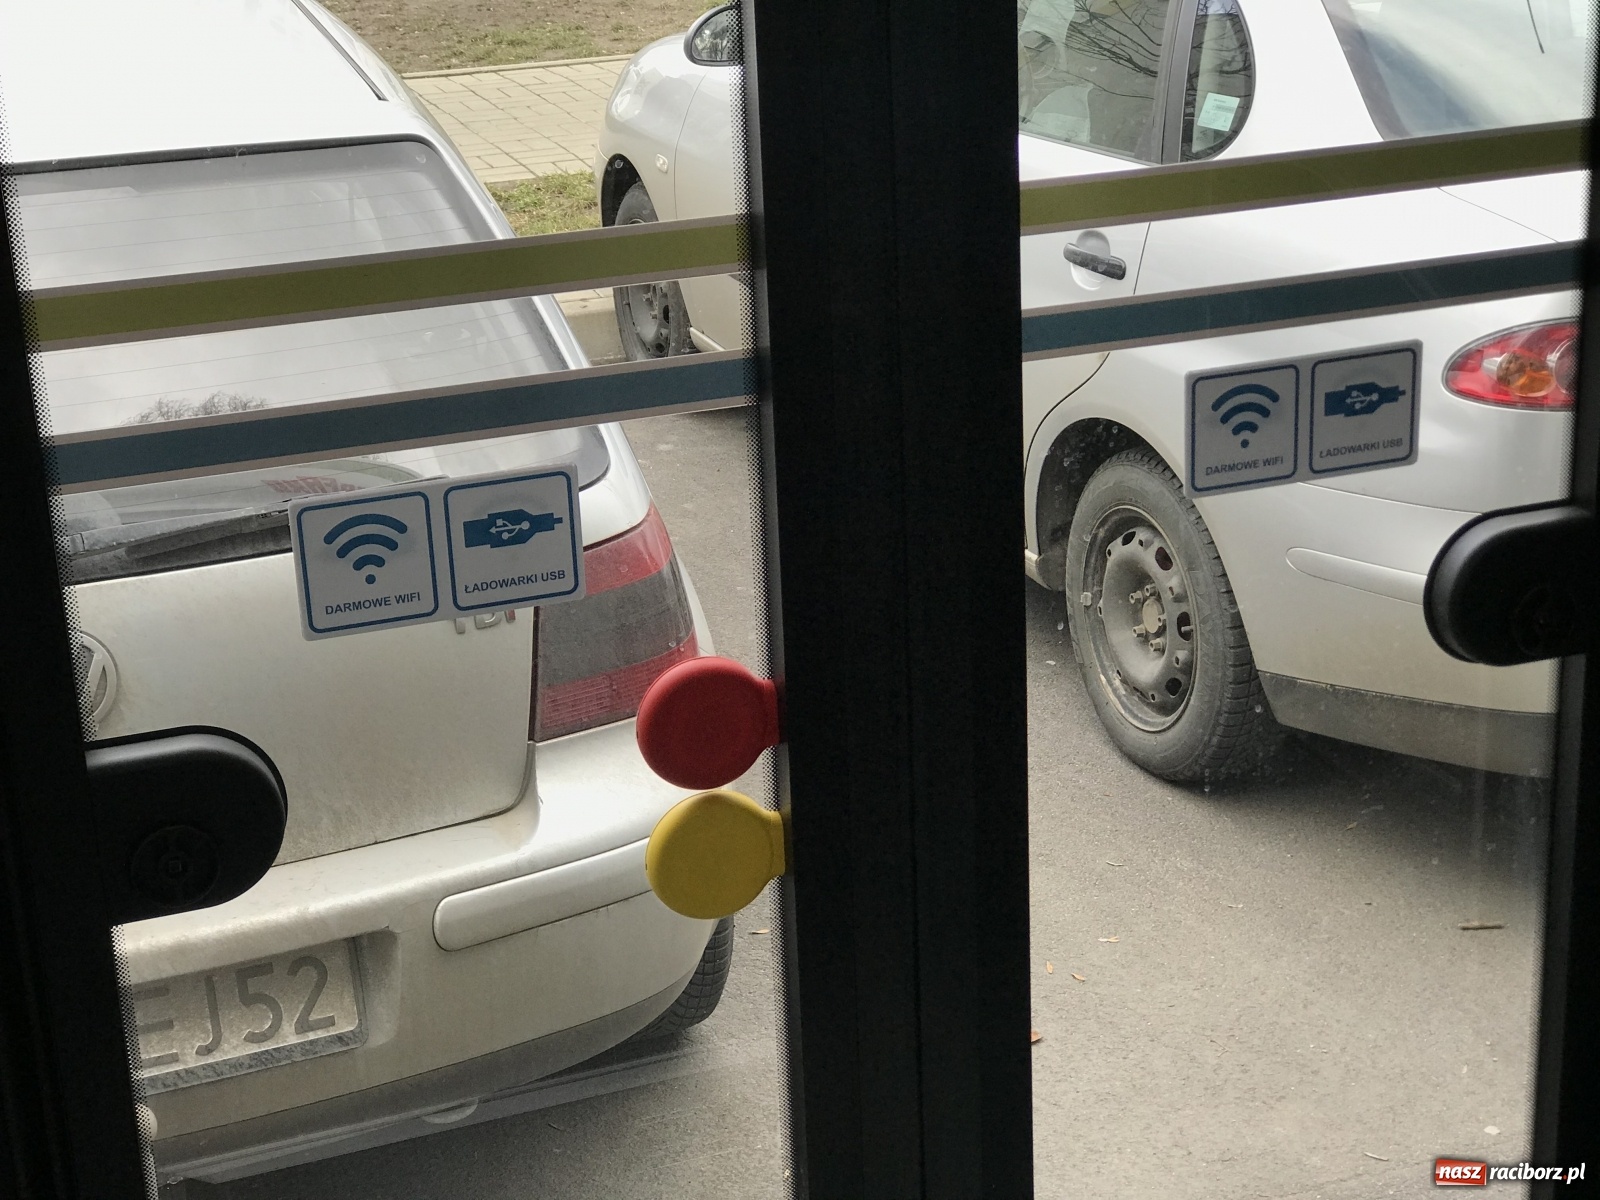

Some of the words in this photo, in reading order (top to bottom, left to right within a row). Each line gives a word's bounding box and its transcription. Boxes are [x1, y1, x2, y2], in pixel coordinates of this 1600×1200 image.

[1319, 440, 1380, 459] ŁADOWARKI
[1382, 437, 1404, 449] USB
[1205, 458, 1260, 476] DARMOWE
[1262, 455, 1284, 467] WIFI
[464, 573, 538, 594] ŁADOWARKI
[540, 569, 566, 582] USB
[324, 595, 392, 616] DARMOWE
[394, 591, 421, 604] WIFI
